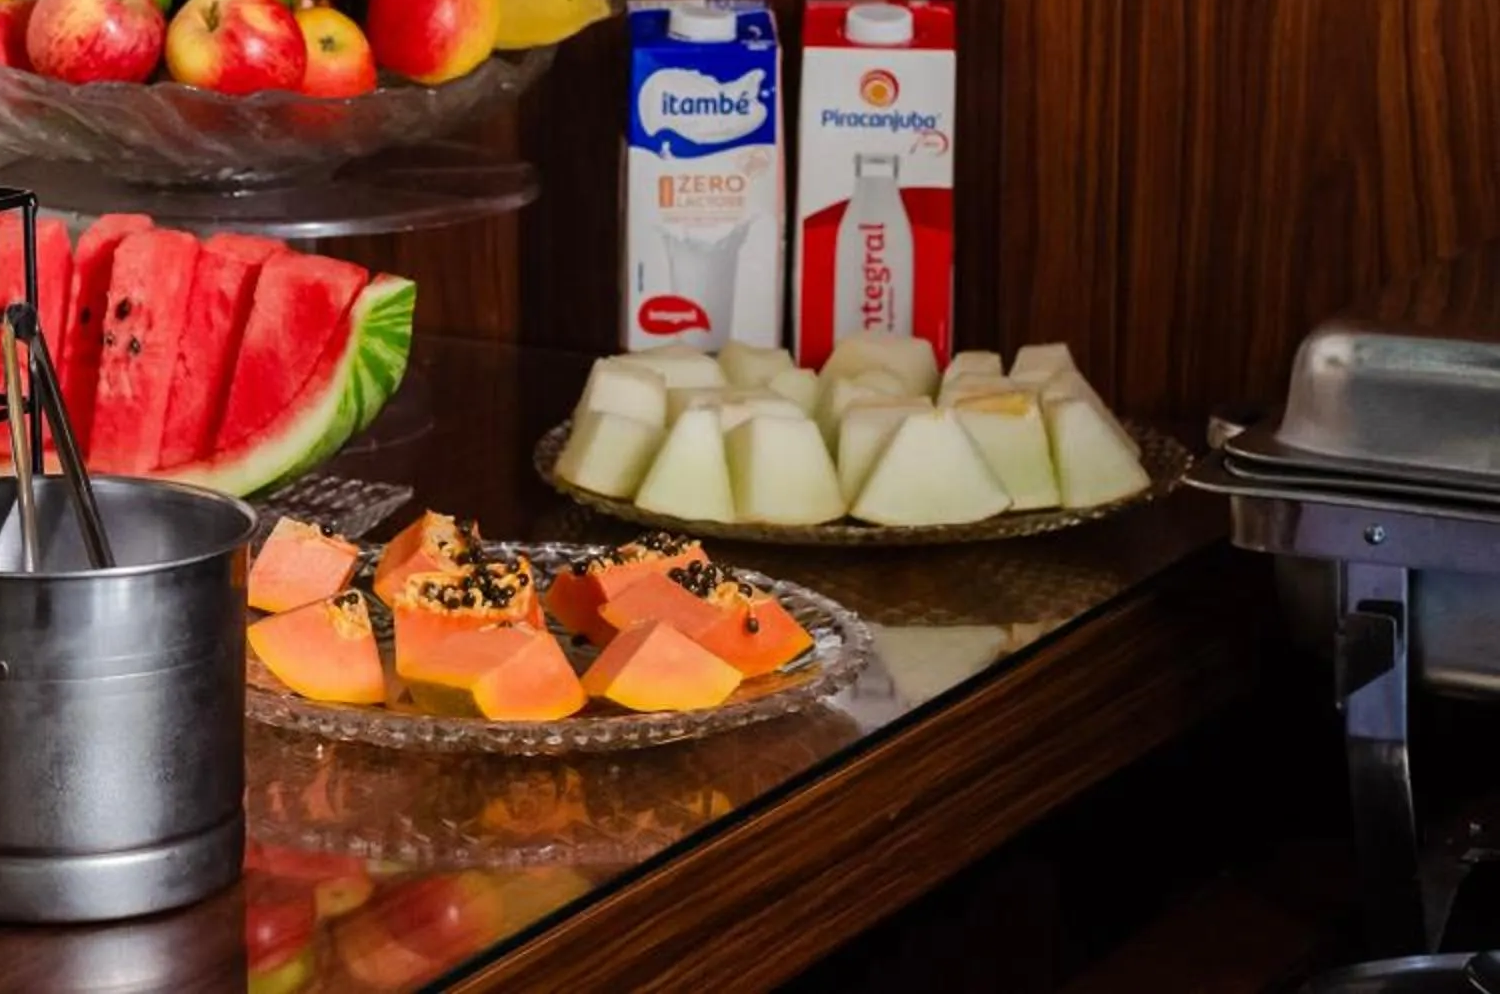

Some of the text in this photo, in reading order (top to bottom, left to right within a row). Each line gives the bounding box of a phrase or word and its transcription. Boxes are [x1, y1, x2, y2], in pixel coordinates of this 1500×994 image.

[661, 90, 749, 115] itambé
[821, 109, 936, 133] Piracanjuba
[677, 174, 746, 193] ZERO
[858, 223, 891, 331] ntegral
